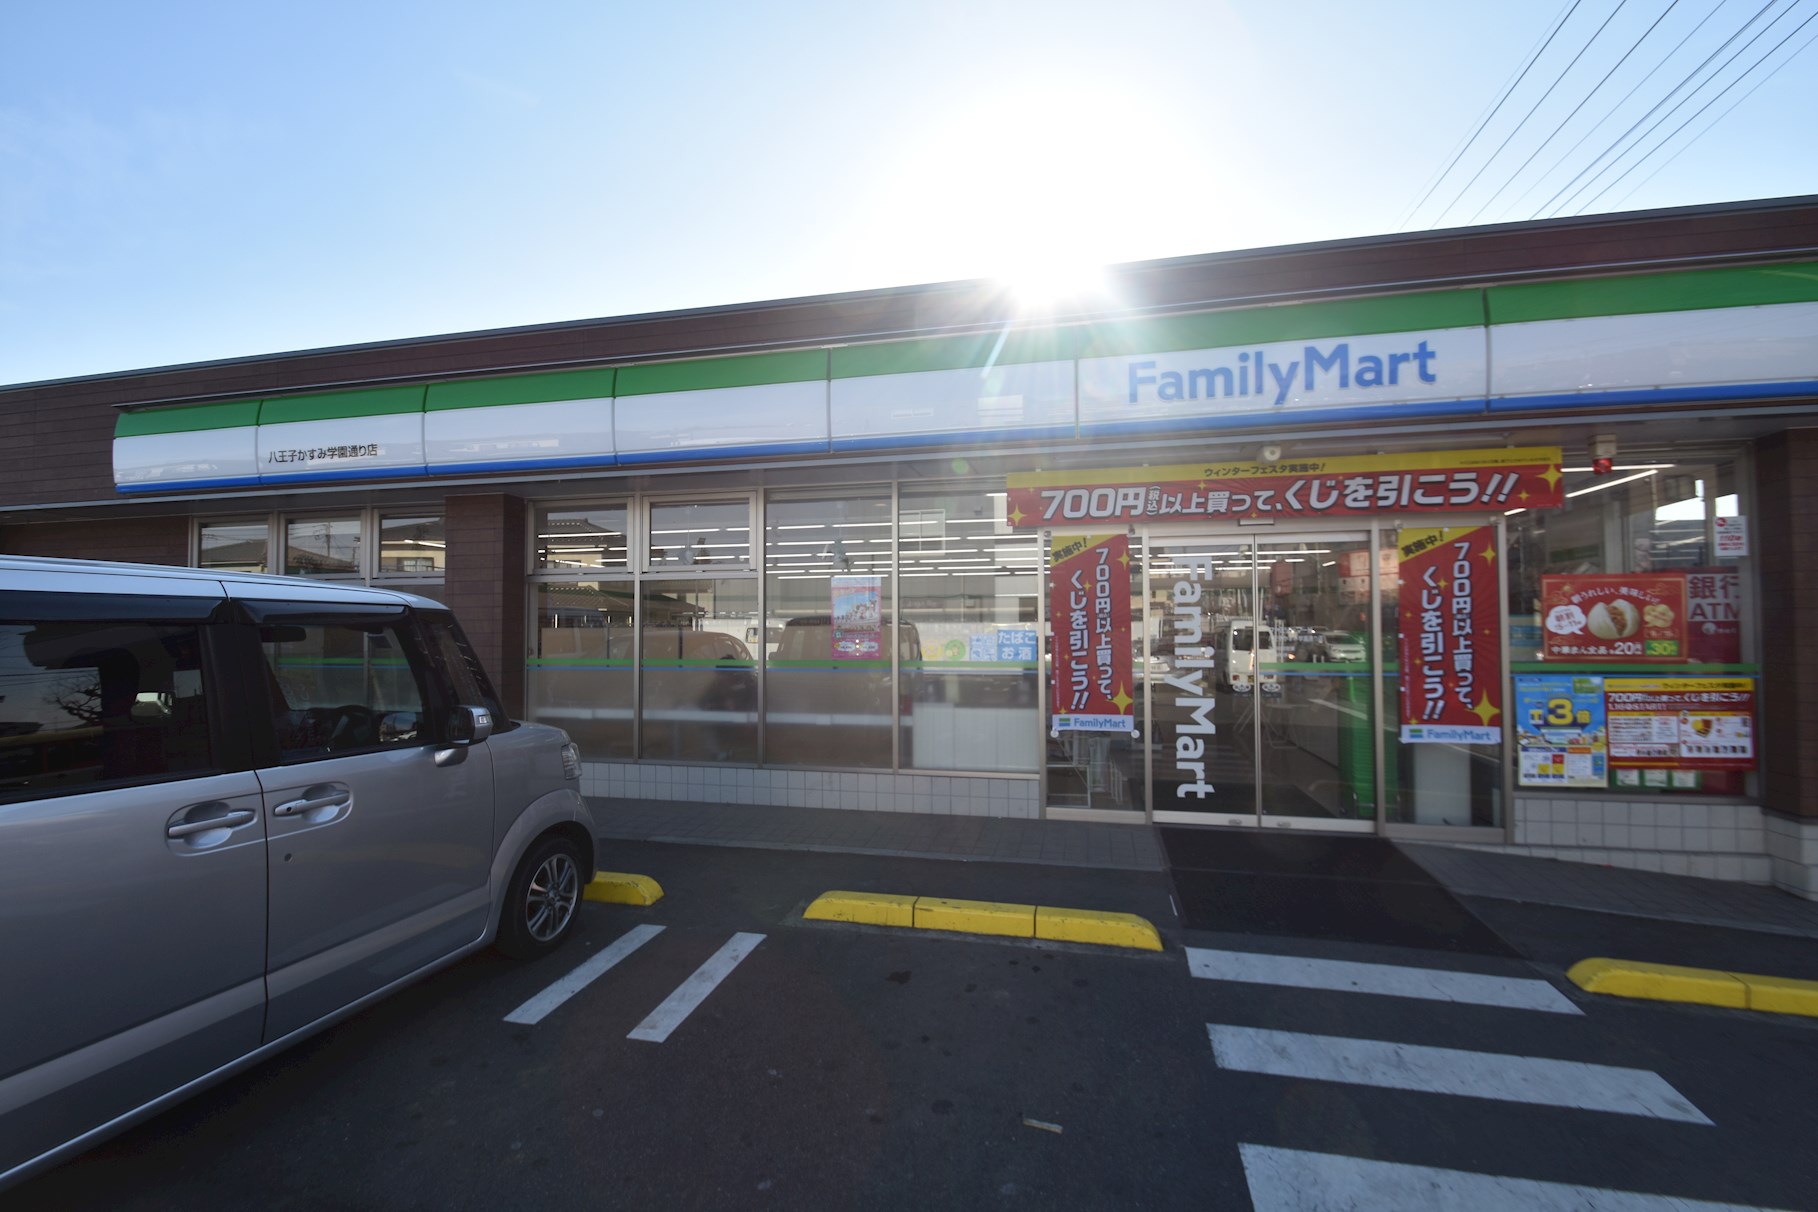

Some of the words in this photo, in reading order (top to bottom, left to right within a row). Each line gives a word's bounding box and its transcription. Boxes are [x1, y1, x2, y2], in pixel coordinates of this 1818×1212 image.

[1127, 340, 1437, 405] FamilyMart
[268, 444, 378, 463] 八王子かすみ学園通り店
[998, 632, 1036, 644] たばこ
[1069, 569, 1090, 710] くじを引こう!!
[1421, 566, 1445, 720] くじを引こう!!
[1001, 646, 1033, 660] お酒
[1164, 556, 1216, 799] FamilyMart
[1074, 718, 1126, 729] FamilyMart
[1427, 728, 1492, 741] FamilyMart
